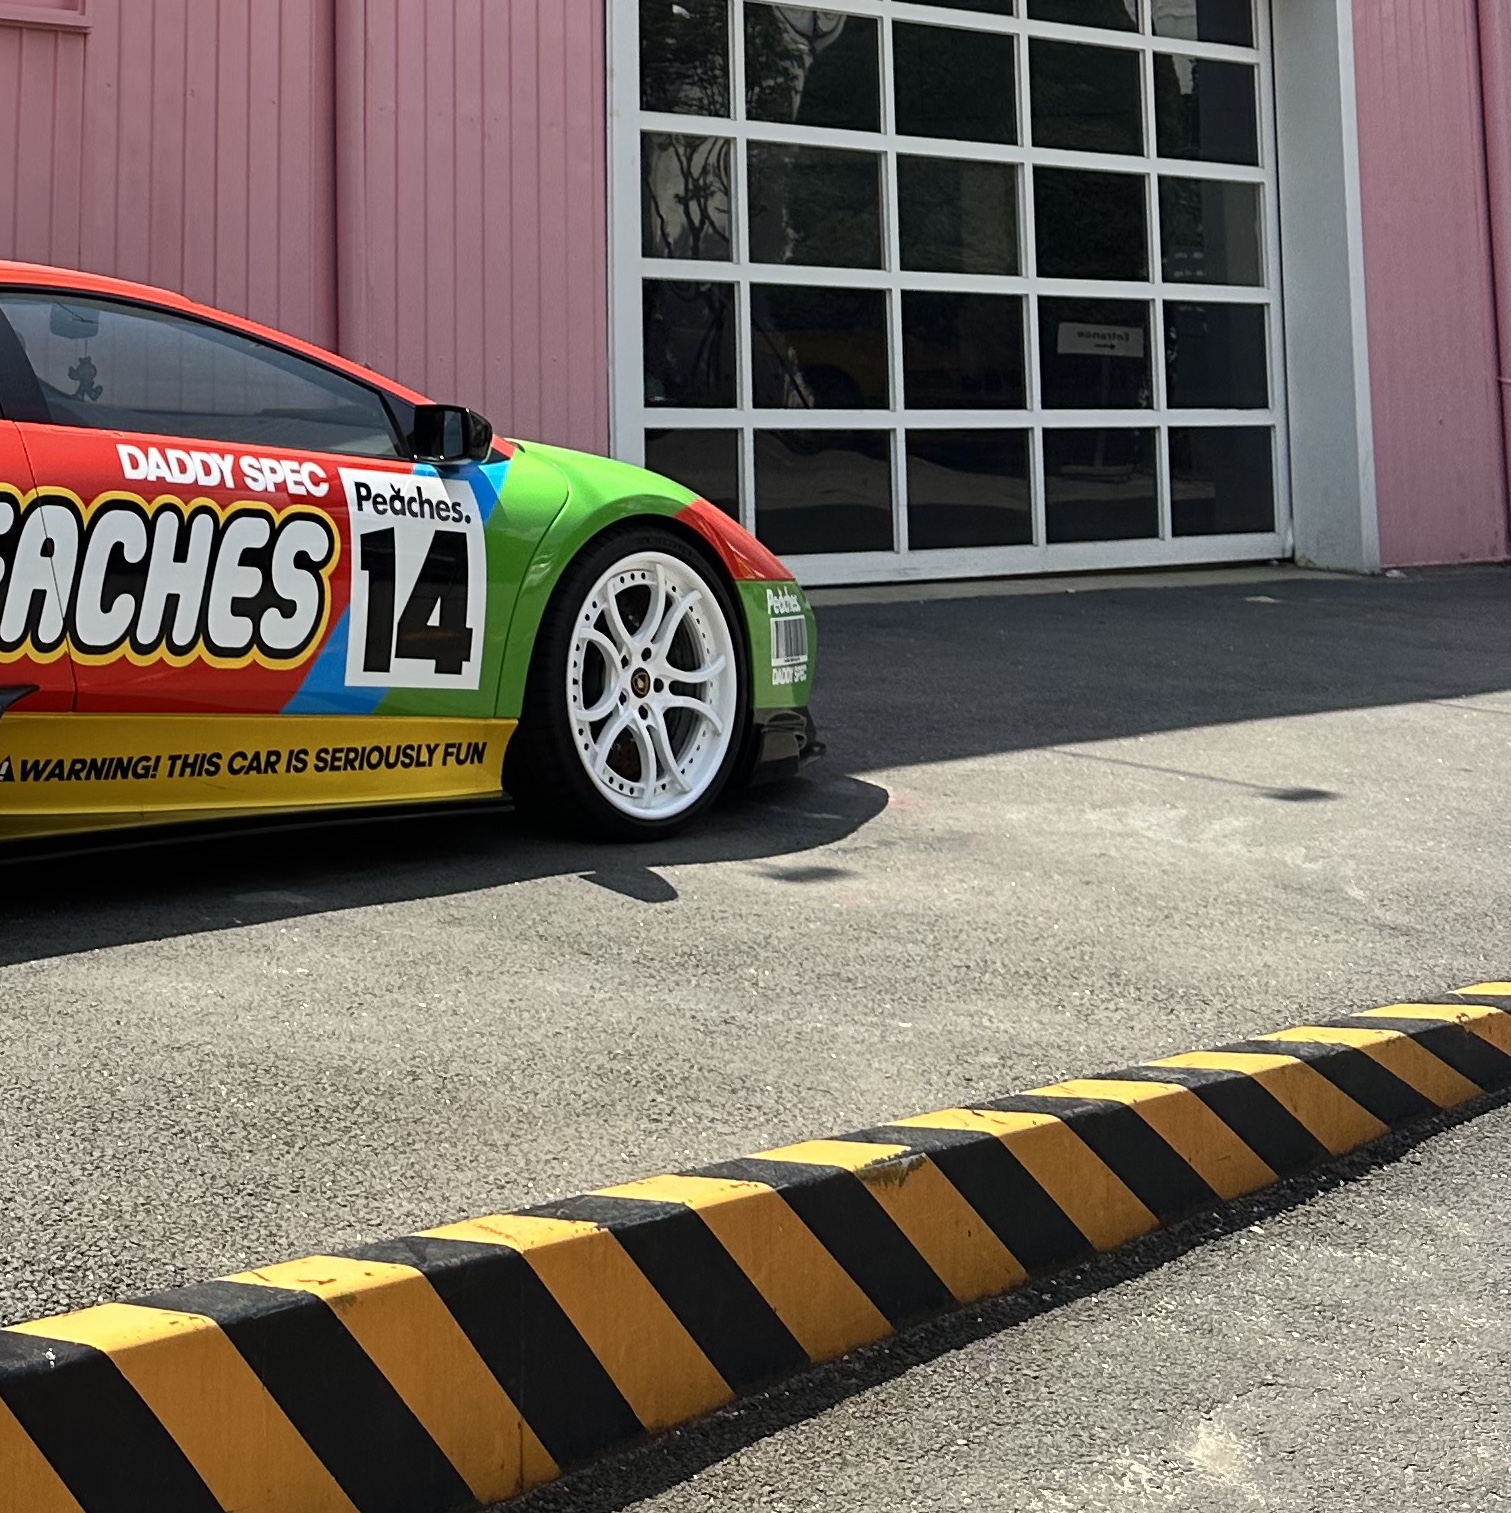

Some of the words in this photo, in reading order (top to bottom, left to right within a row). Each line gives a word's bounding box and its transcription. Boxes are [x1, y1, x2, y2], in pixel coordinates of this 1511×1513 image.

[116, 443, 234, 489] DADDY
[240, 455, 329, 498] SPEC
[360, 526, 473, 675] 14
[20, 755, 162, 783] WARNING!
[167, 751, 223, 778] THIS
[227, 749, 282, 776] CAR
[285, 747, 310, 774] IS
[313, 742, 440, 773] SERIOUSLY
[442, 741, 487, 767] FUN
